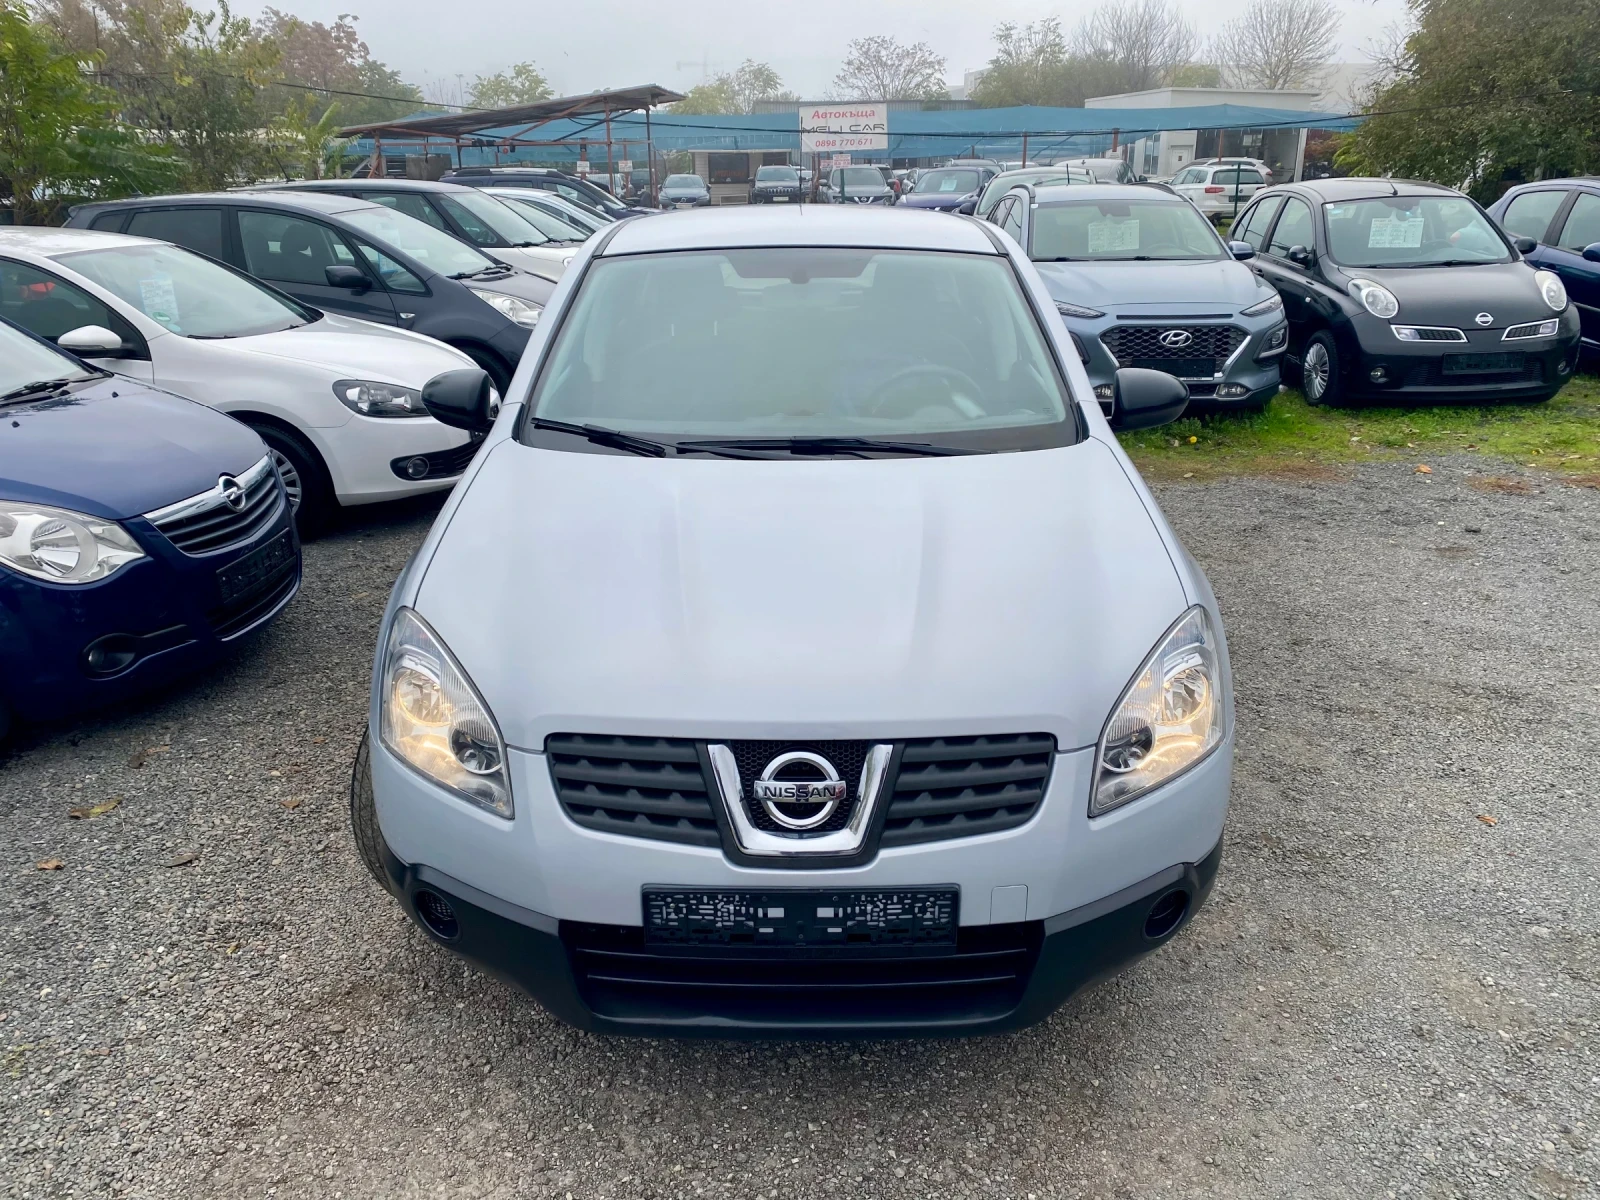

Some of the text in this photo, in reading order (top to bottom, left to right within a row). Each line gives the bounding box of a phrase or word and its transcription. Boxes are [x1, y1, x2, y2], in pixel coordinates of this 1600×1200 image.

[812, 109, 876, 119] Автокъща
[857, 138, 873, 146] 671
[764, 786, 836, 798] NISSAN
